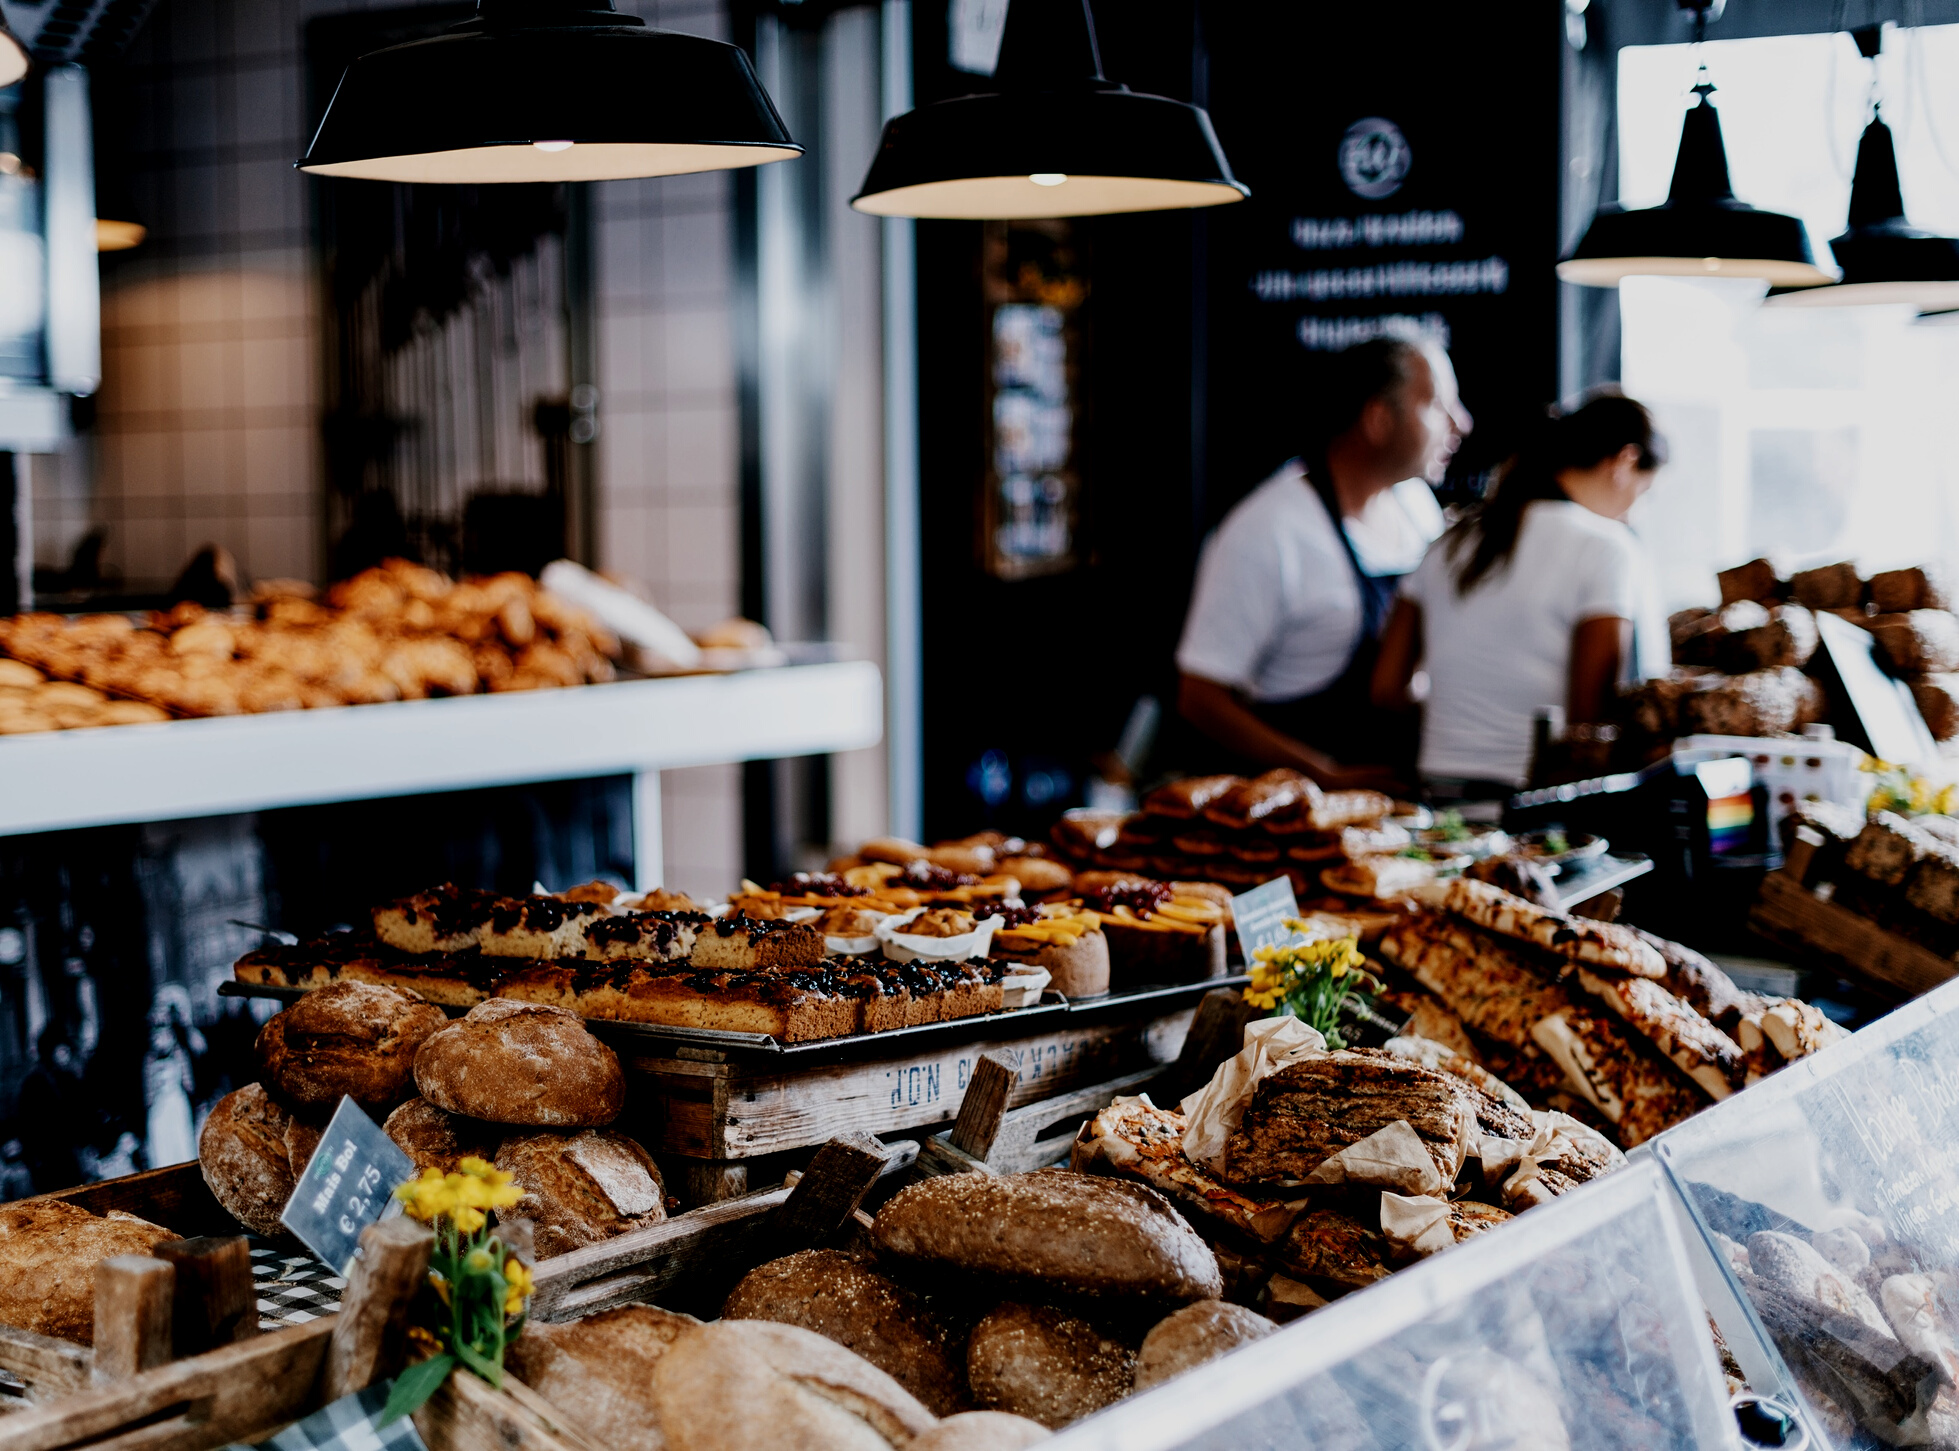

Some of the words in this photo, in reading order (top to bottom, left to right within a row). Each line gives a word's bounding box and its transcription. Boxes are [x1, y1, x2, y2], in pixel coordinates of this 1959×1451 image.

[312, 1171, 341, 1216] Mais
[334, 1139, 358, 1173] Bol
[340, 1214, 356, 1235] €
[348, 1164, 381, 1217] 2,75
